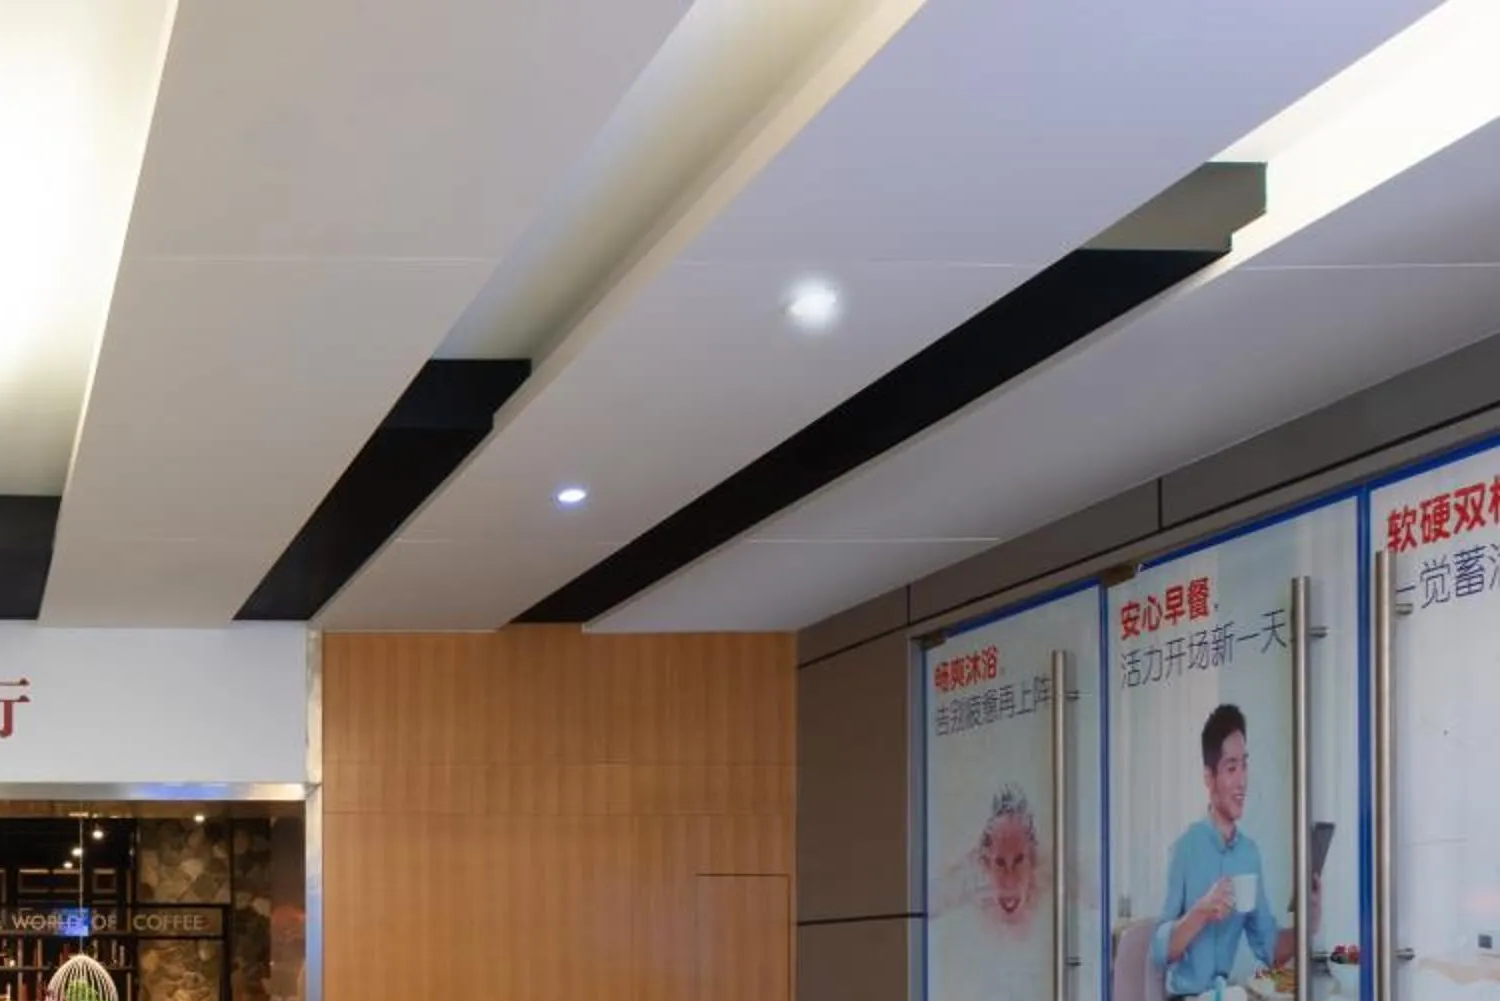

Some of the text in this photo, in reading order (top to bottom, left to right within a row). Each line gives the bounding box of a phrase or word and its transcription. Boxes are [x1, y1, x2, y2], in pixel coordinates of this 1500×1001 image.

[1121, 608, 1288, 690] 活力开场新一天
[93, 913, 118, 931] OF
[132, 913, 204, 931] COFFEE
